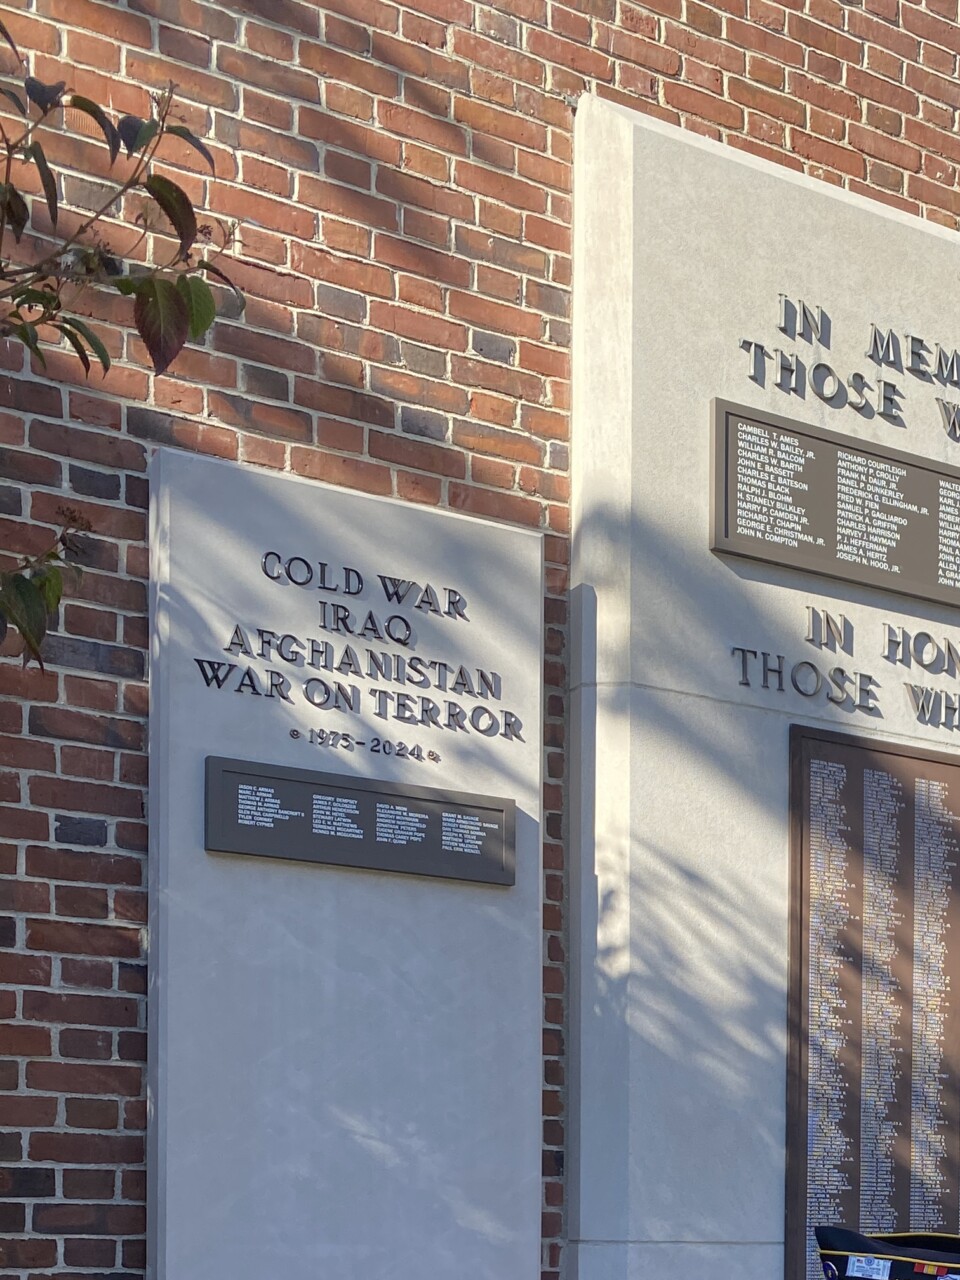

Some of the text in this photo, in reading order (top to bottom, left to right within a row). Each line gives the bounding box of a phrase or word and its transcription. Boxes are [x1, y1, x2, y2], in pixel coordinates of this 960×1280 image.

[778, 293, 823, 340] IN
[739, 337, 900, 417] THOSE
[737, 422, 770, 438] CAMBELL
[779, 434, 799, 446] AMES
[737, 431, 769, 446] CHARLES
[780, 443, 805, 457] BAILEY,
[805, 450, 815, 459] JR.
[737, 439, 767, 454] WILLIAM
[777, 450, 805, 464] BALCOM
[737, 448, 769, 463] CHARLES
[780, 460, 803, 472] BARTH
[837, 450, 906, 476] RICHARD COURTLEIGH
[737, 457, 756, 468] JOHN
[764, 464, 794, 478] BASSETT
[737, 465, 769, 480] CHARLES
[777, 476, 808, 491] BATESON
[837, 459, 868, 474] ANTHONY
[875, 470, 899, 482] CROLLY
[837, 467, 859, 480] FRANK
[868, 476, 887, 488] DAUR,
[888, 482, 898, 490] JR.
[737, 473, 790, 494] THOMAS BLACK
[737, 482, 760, 495] RALPH
[768, 490, 792, 503] BLOHM
[737, 499, 761, 512] HARRY
[769, 508, 798, 522] CAMDEN
[799, 516, 809, 525] JR.
[745, 493, 775, 507] STANELY
[776, 501, 806, 515] BULKLEY
[837, 484, 872, 500] FREDERICK
[881, 496, 919, 513] ELLINGHAM,
[920, 507, 929, 515] JR.
[737, 508, 768, 522] RICHARD
[776, 518, 801, 531] CHAPIN
[836, 500, 863, 514] SAMUEL
[871, 510, 908, 526] GAGLIARDO
[736, 517, 765, 530] GEORGE
[774, 526, 815, 544] CHRISTMAN,
[815, 537, 825, 546] JR.
[736, 526, 755, 537] JOHN
[764, 532, 798, 548] COMPTON
[836, 517, 900, 540] CHARLES HARRISON
[836, 525, 862, 538] HARVEY
[869, 534, 896, 547] HAYMAN
[836, 542, 857, 554] JAMES
[866, 550, 887, 562] HERTZ
[836, 551, 861, 563] JOSEPH
[870, 559, 890, 571] HOOD,
[890, 565, 900, 573] JR.
[261, 551, 468, 620] COLD WAR
[318, 600, 412, 646] IRAQ
[805, 606, 845, 648] IN
[223, 623, 497, 698] AFGHANISTAN
[731, 647, 875, 711] THOSE
[193, 658, 523, 739] WAR ON TERROR
